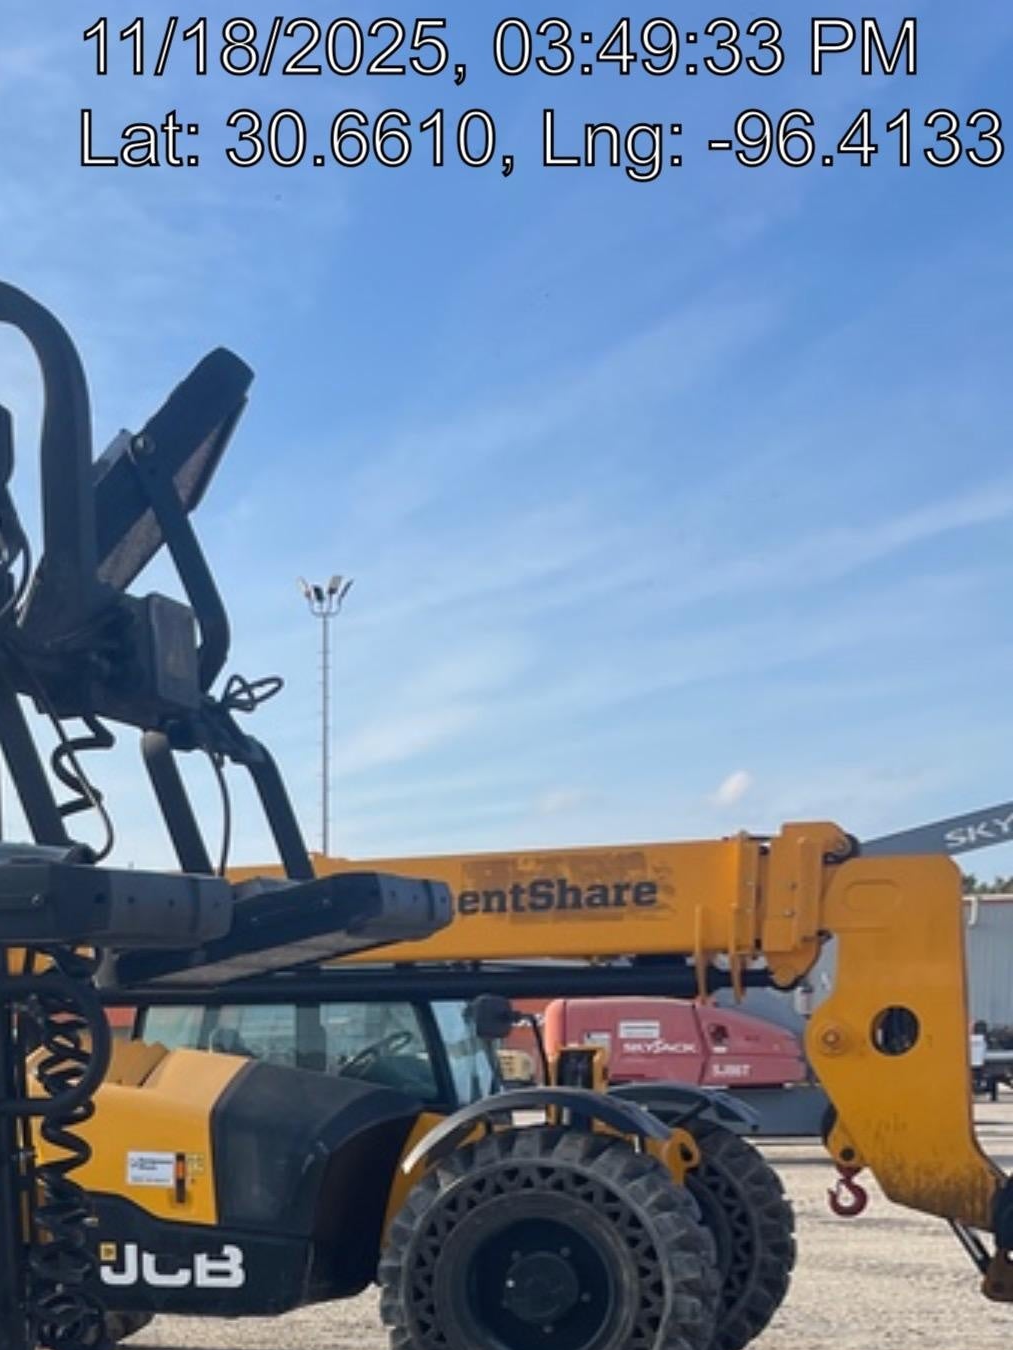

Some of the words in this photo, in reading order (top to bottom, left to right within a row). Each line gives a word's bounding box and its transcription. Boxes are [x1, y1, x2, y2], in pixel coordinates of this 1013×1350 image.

[944, 812, 1013, 849] SKY
[457, 878, 658, 915] entShare
[99, 1242, 246, 1289] JCB
